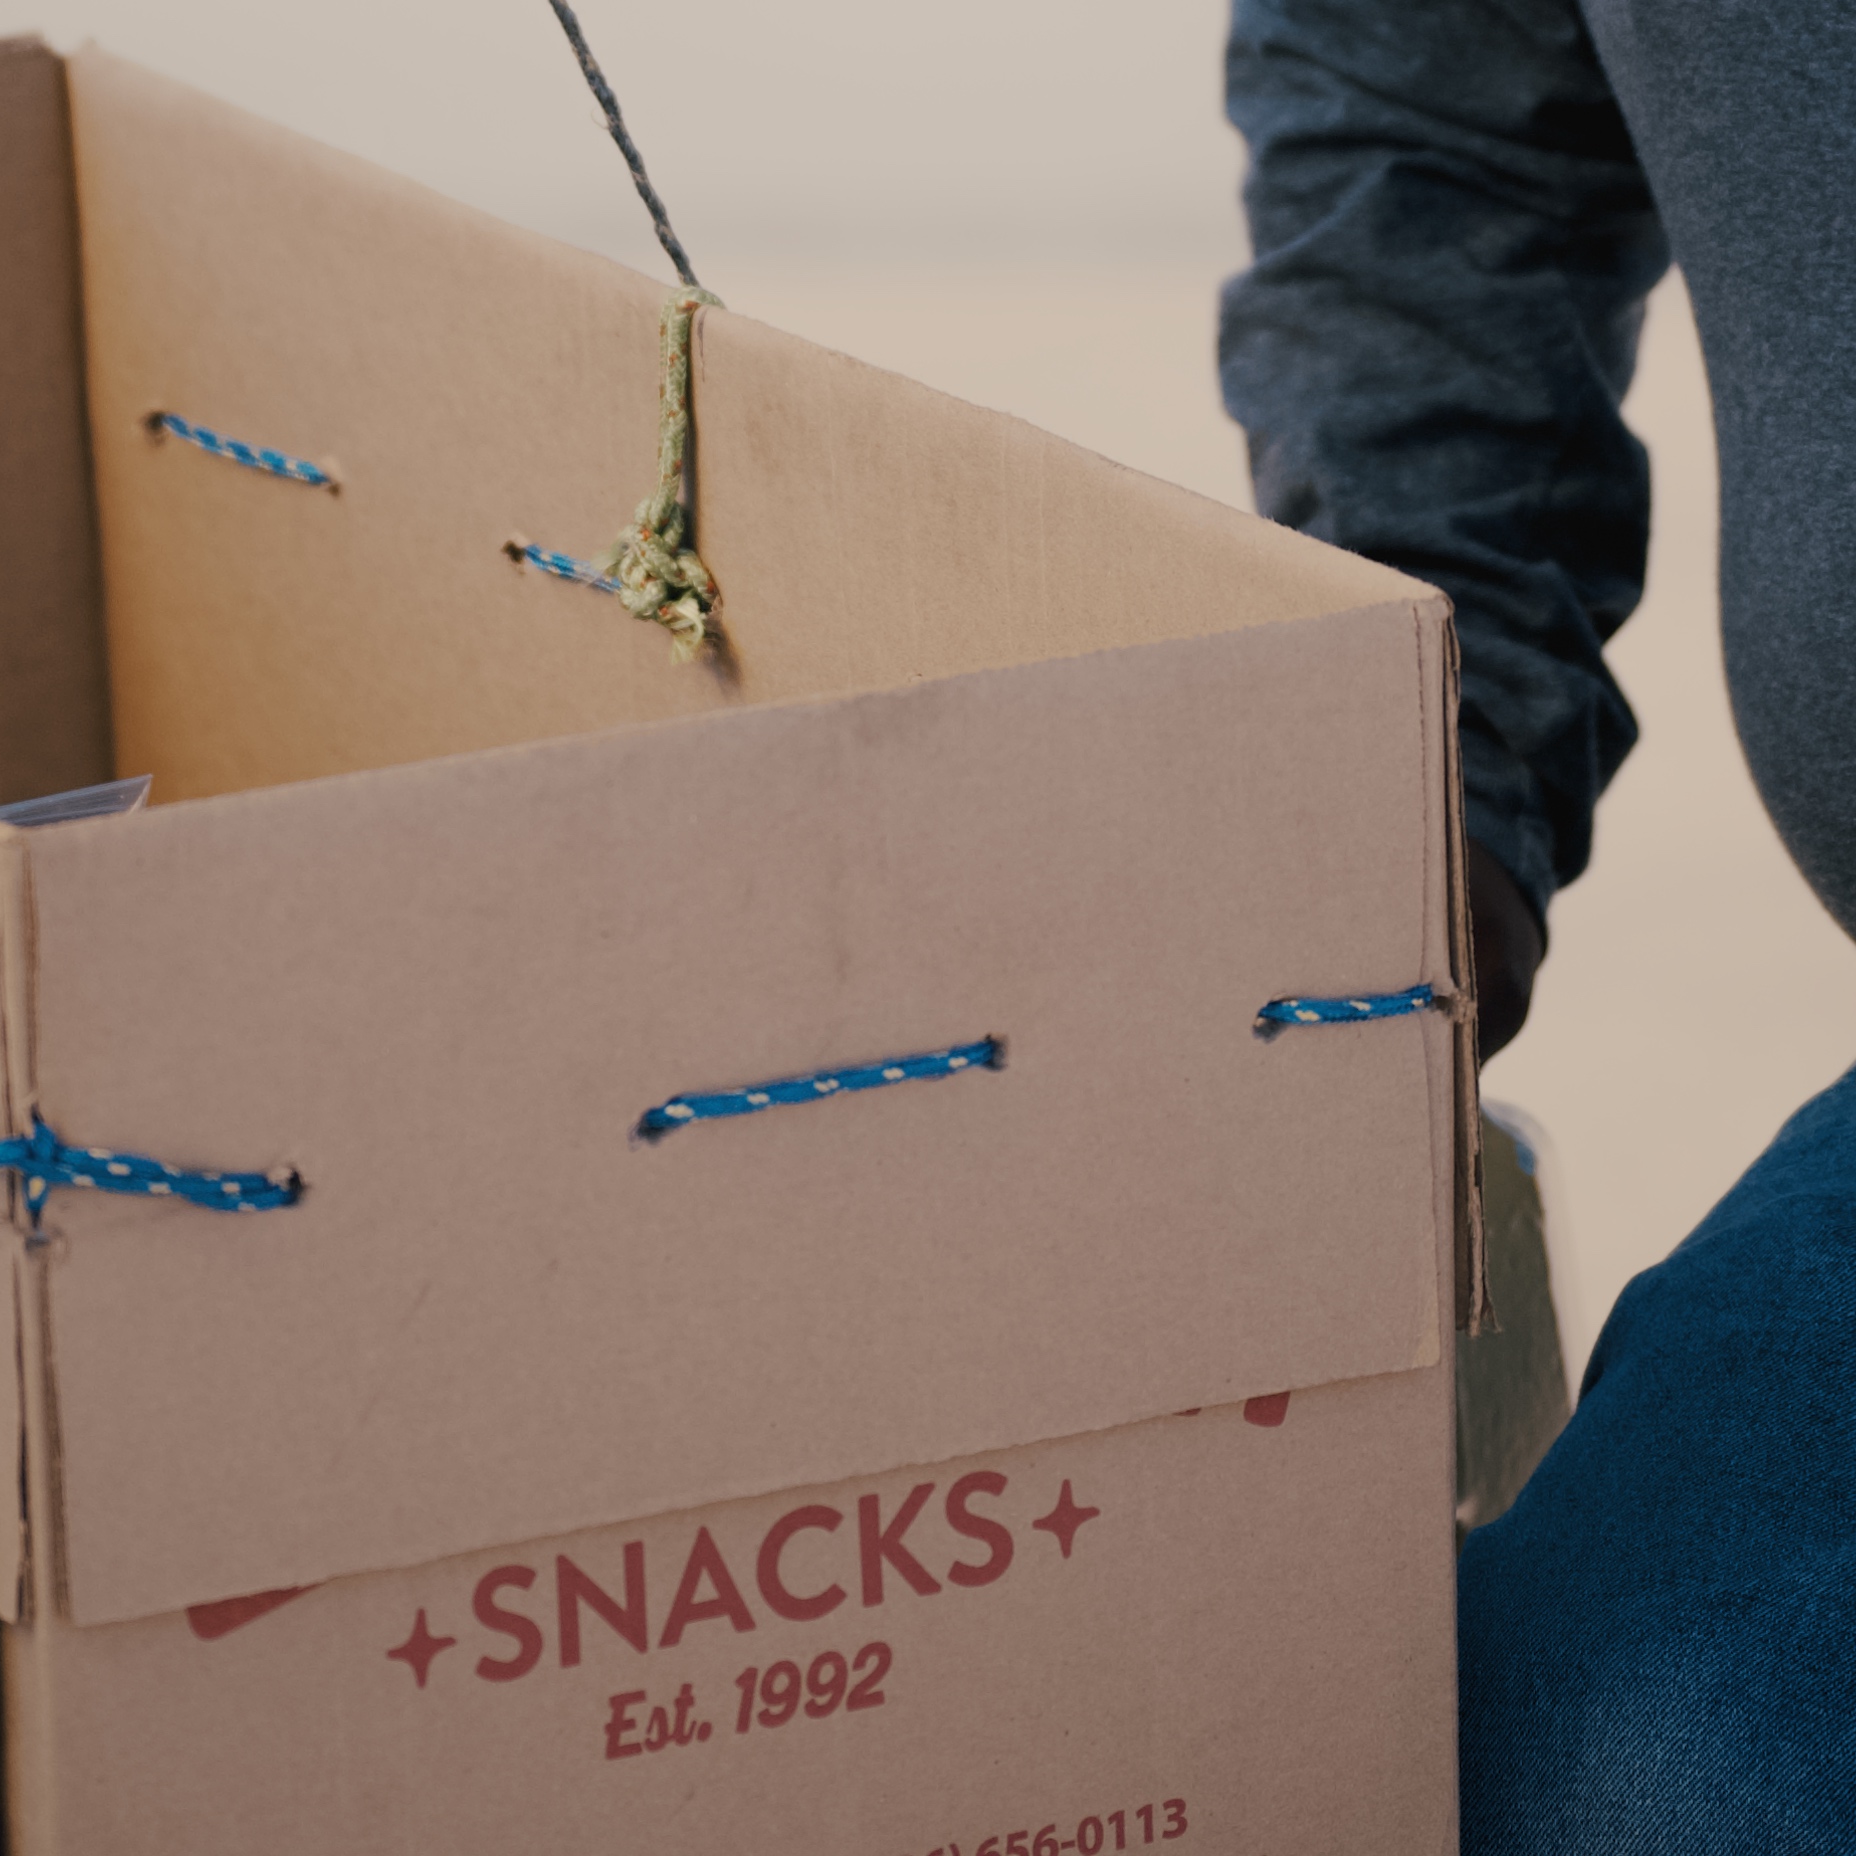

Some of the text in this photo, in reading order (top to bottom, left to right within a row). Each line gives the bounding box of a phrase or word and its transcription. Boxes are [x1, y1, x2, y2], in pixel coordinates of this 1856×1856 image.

[472, 1471, 1014, 1683] SNACKS
[604, 1642, 893, 1758] Est. 1992
